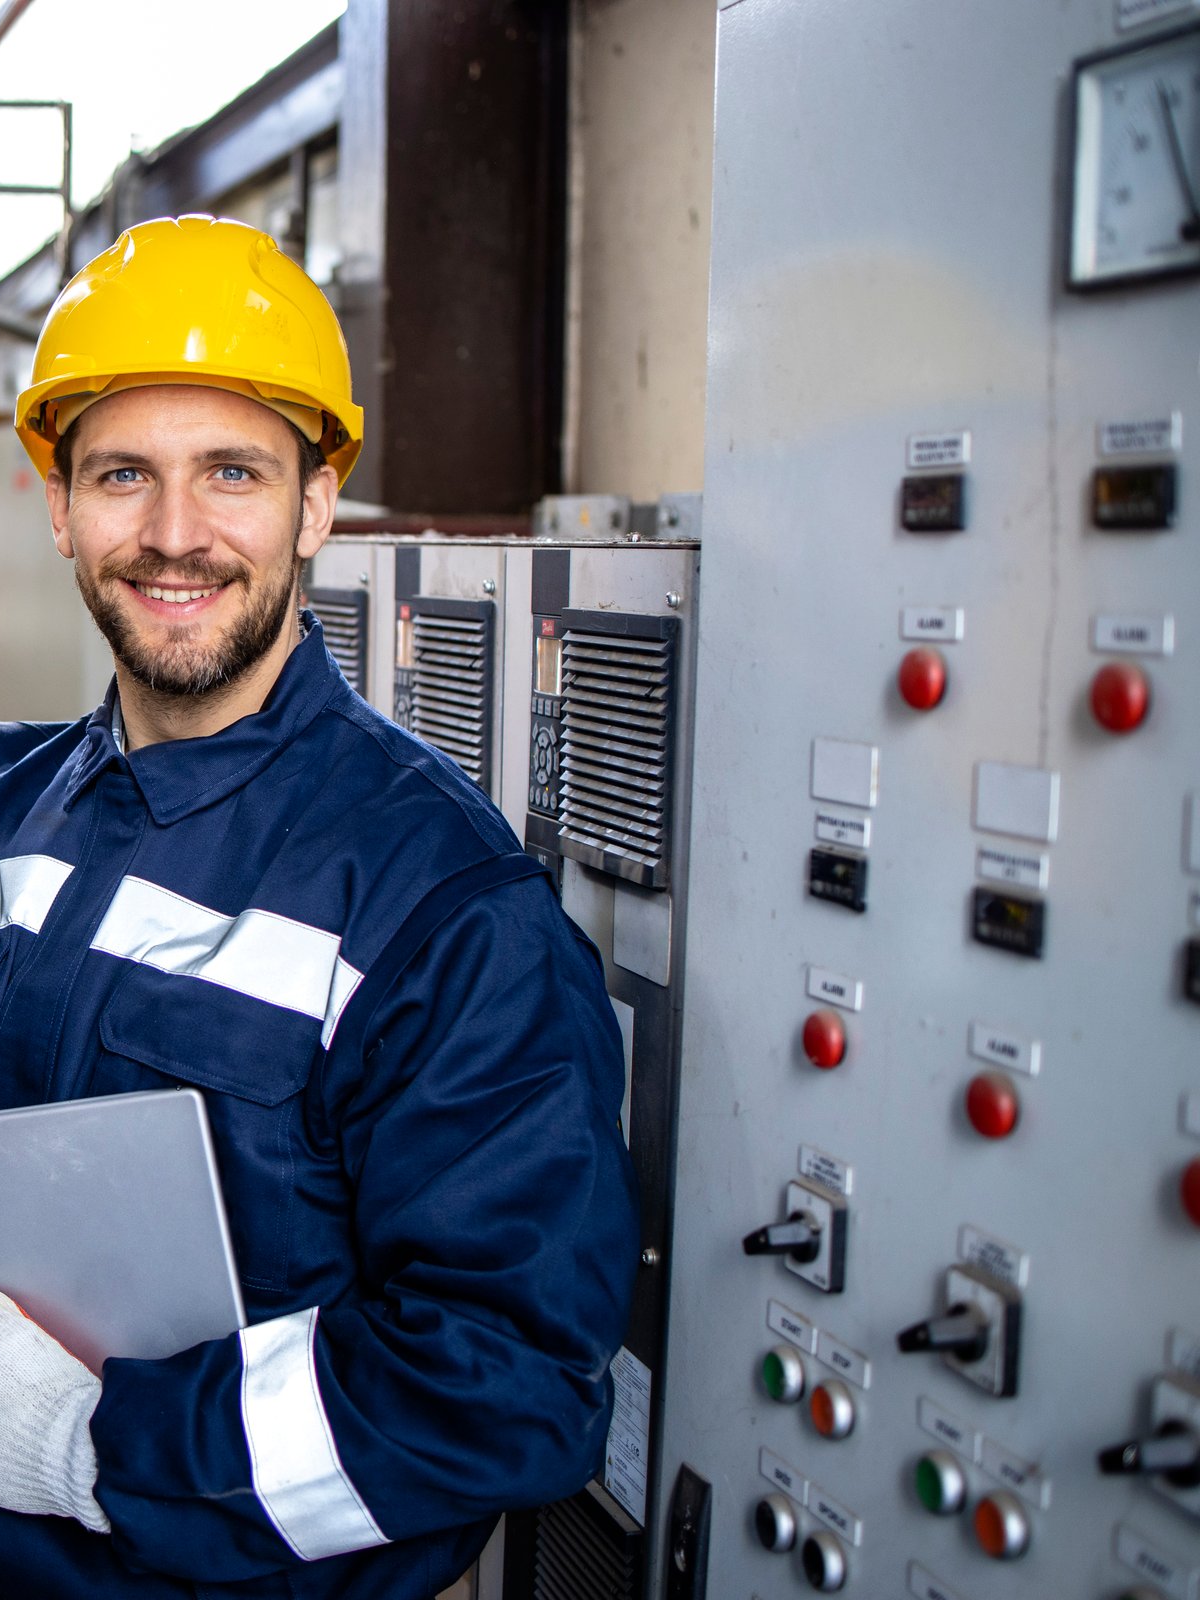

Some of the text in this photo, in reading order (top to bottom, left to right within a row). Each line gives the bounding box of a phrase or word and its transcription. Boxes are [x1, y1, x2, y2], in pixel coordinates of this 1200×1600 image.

[917, 618, 945, 630] ALARM
[821, 980, 846, 997] ALARM
[781, 1317, 802, 1336] START
[832, 1352, 851, 1369] STOP
